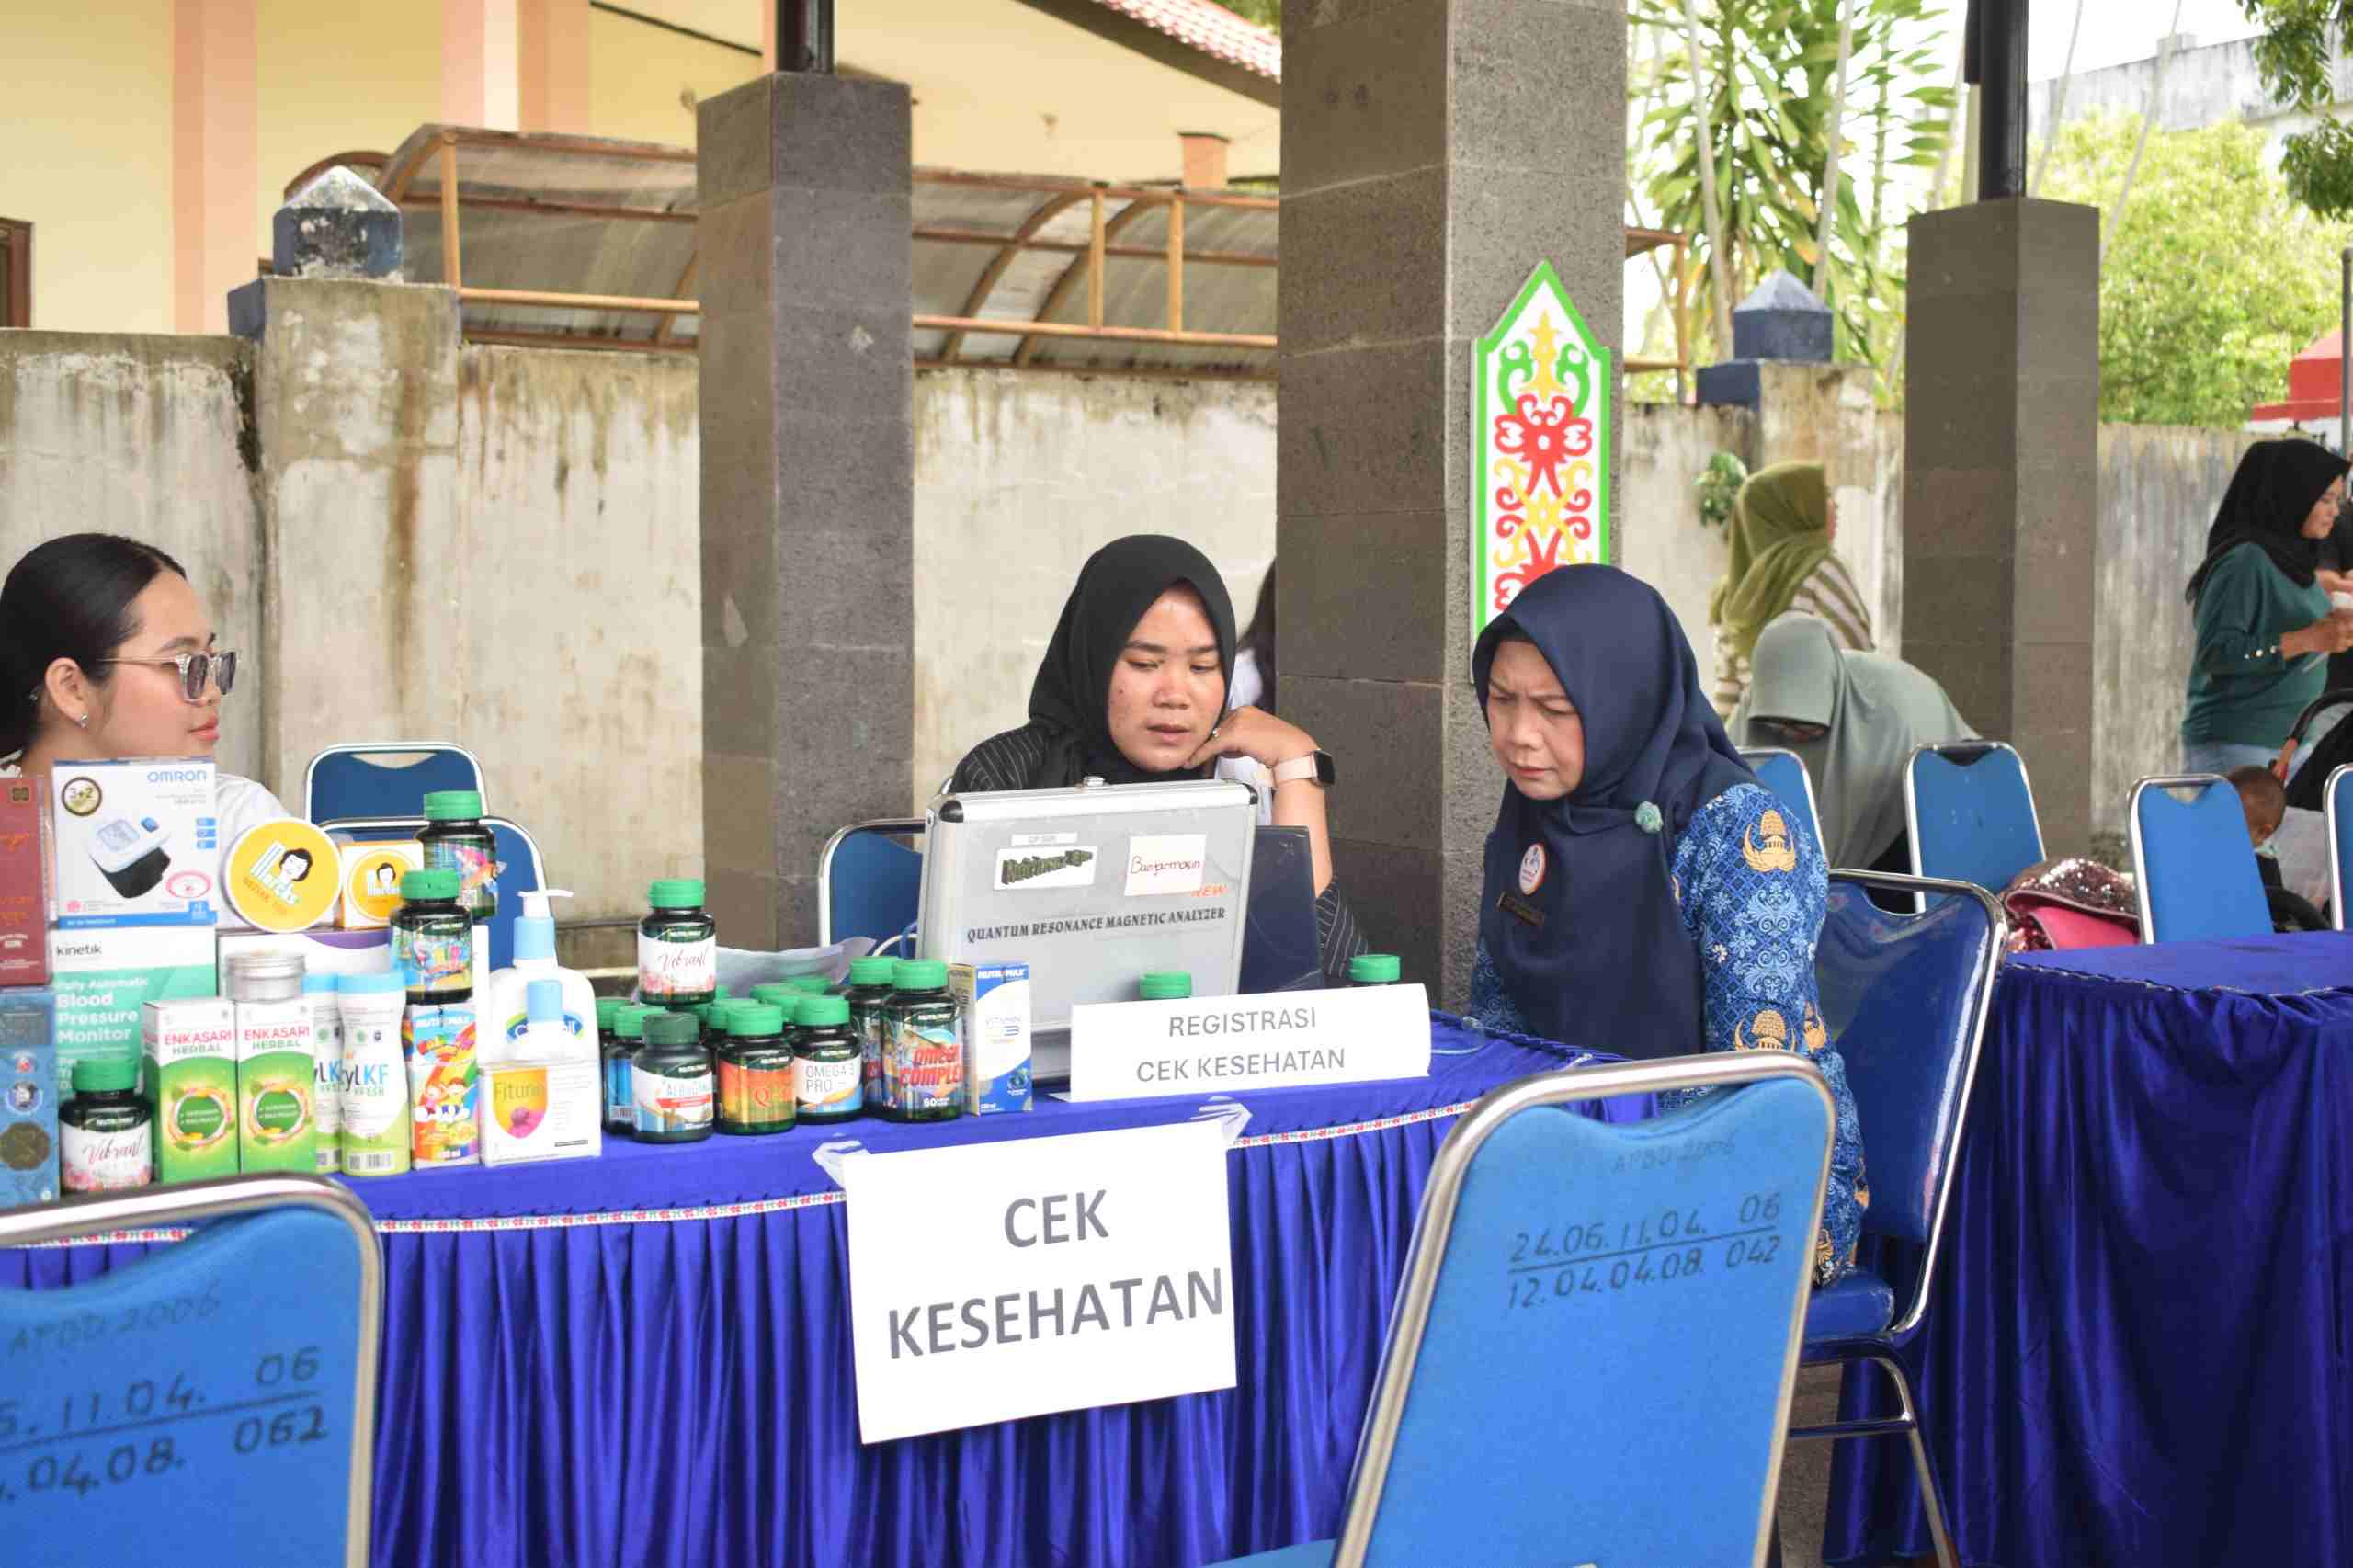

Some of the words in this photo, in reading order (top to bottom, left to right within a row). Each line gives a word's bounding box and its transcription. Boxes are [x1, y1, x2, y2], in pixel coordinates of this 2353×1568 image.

[147, 770, 207, 783] OMRON
[967, 924, 1029, 944] QUANTUM
[1031, 917, 1103, 936] RESONANCE
[1106, 912, 1166, 929] MAGNETIC
[1168, 906, 1226, 924] ANALYZER
[56, 943, 102, 957] kinetik
[56, 992, 114, 1008] Blood
[56, 1010, 138, 1027] Pressure
[1168, 1006, 1316, 1038] REGISTRASI
[57, 1028, 132, 1044] Monitor
[172, 1043, 222, 1056] HERBAL
[252, 1039, 301, 1051] HERBAL
[1136, 1059, 1189, 1083] CEK
[1197, 1048, 1346, 1079] KESEHATAN
[1005, 1189, 1108, 1248] CEK
[888, 1267, 1223, 1359] KESEHATAN
[256, 1345, 320, 1386] 06
